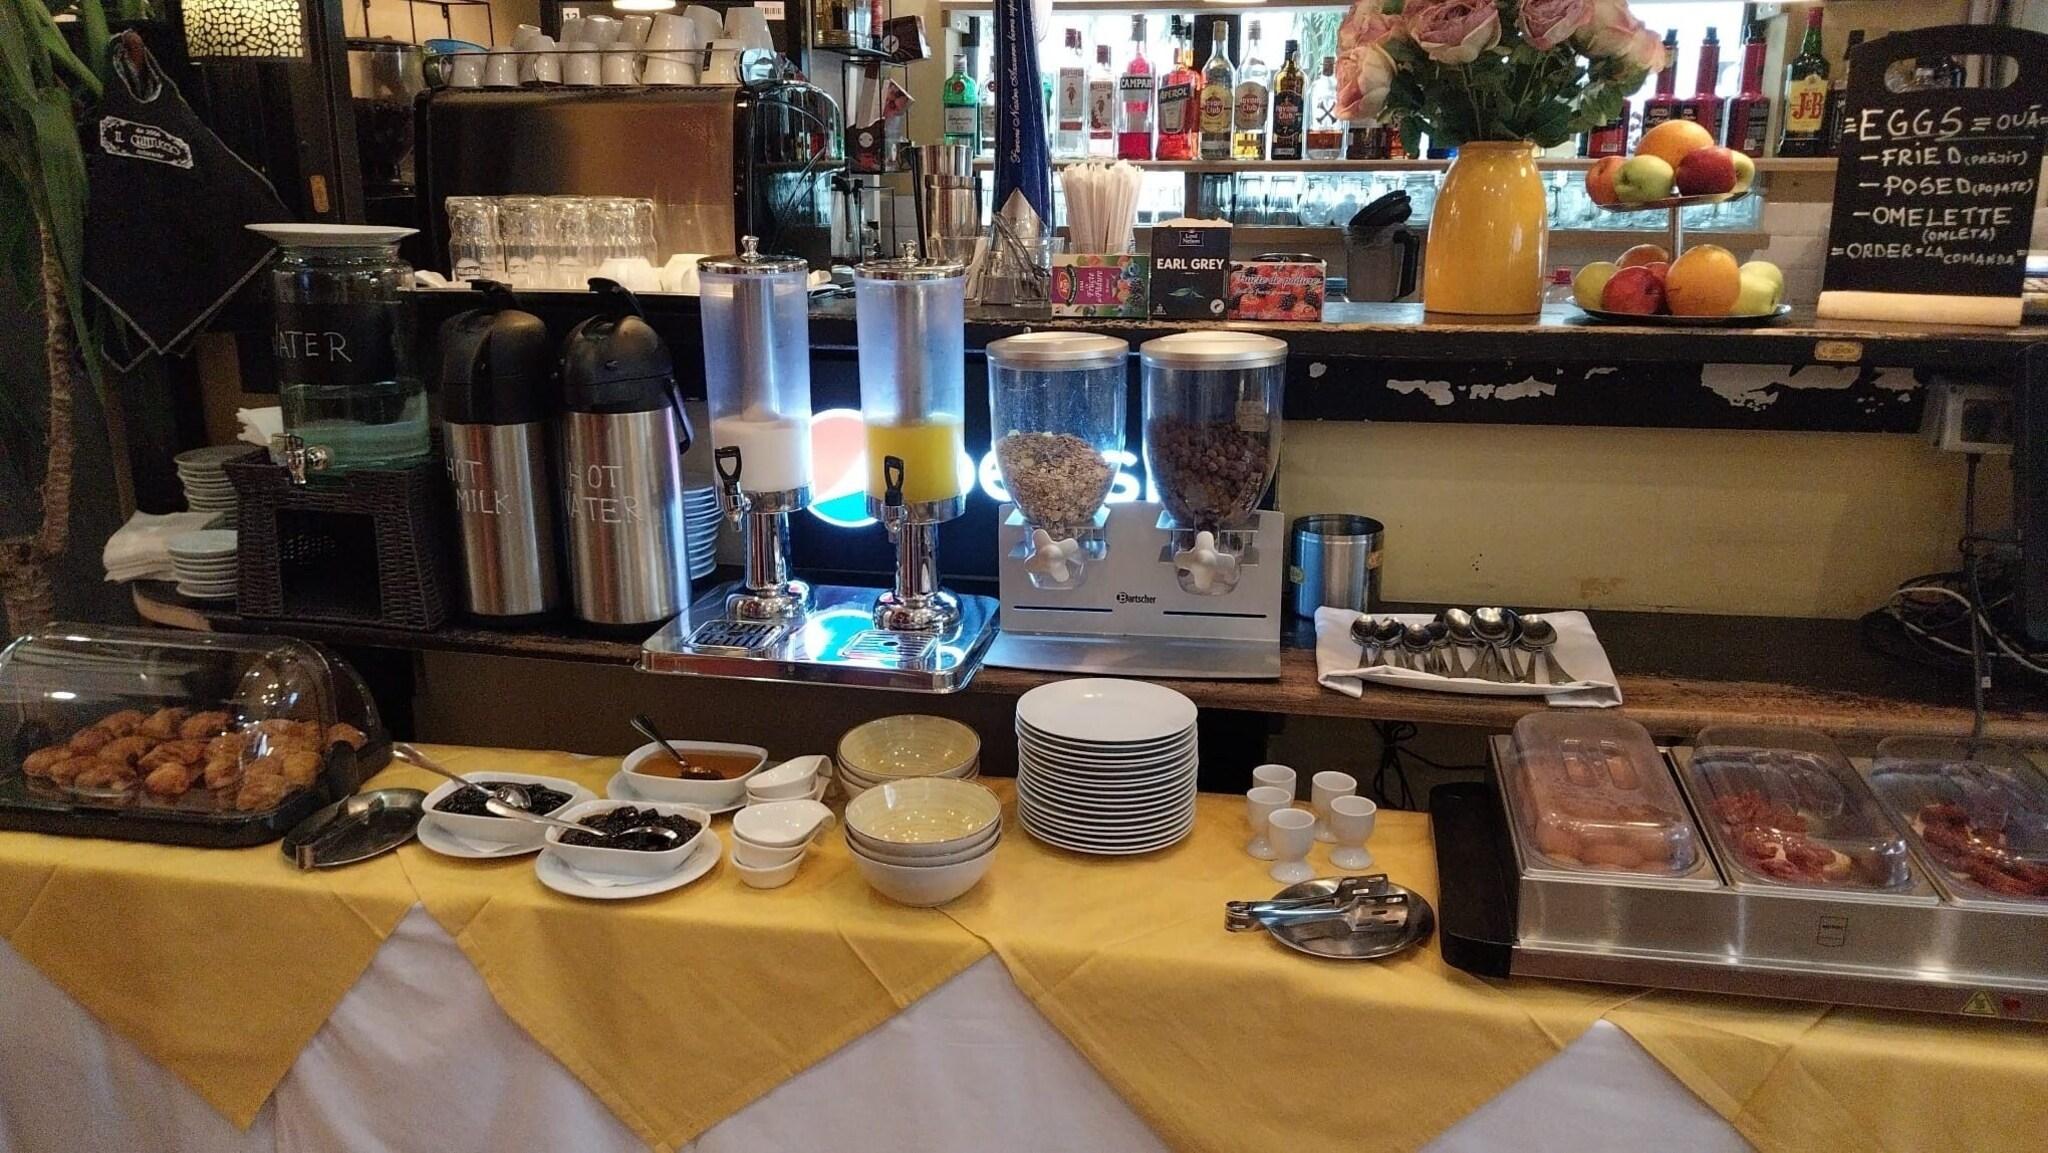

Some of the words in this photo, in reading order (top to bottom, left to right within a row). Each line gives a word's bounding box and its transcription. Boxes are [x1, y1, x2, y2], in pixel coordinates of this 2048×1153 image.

[1120, 77, 1152, 89] CAMPARI
[1159, 87, 1188, 100] APEROL
[1859, 106, 1963, 142] EGGS
[1156, 258, 1188, 270] EARL
[1190, 258, 1225, 270] GREY
[446, 456, 483, 484] HOT
[568, 461, 624, 489] HOT
[456, 489, 512, 515] MILK
[1116, 591, 1156, 604] Bartscher
